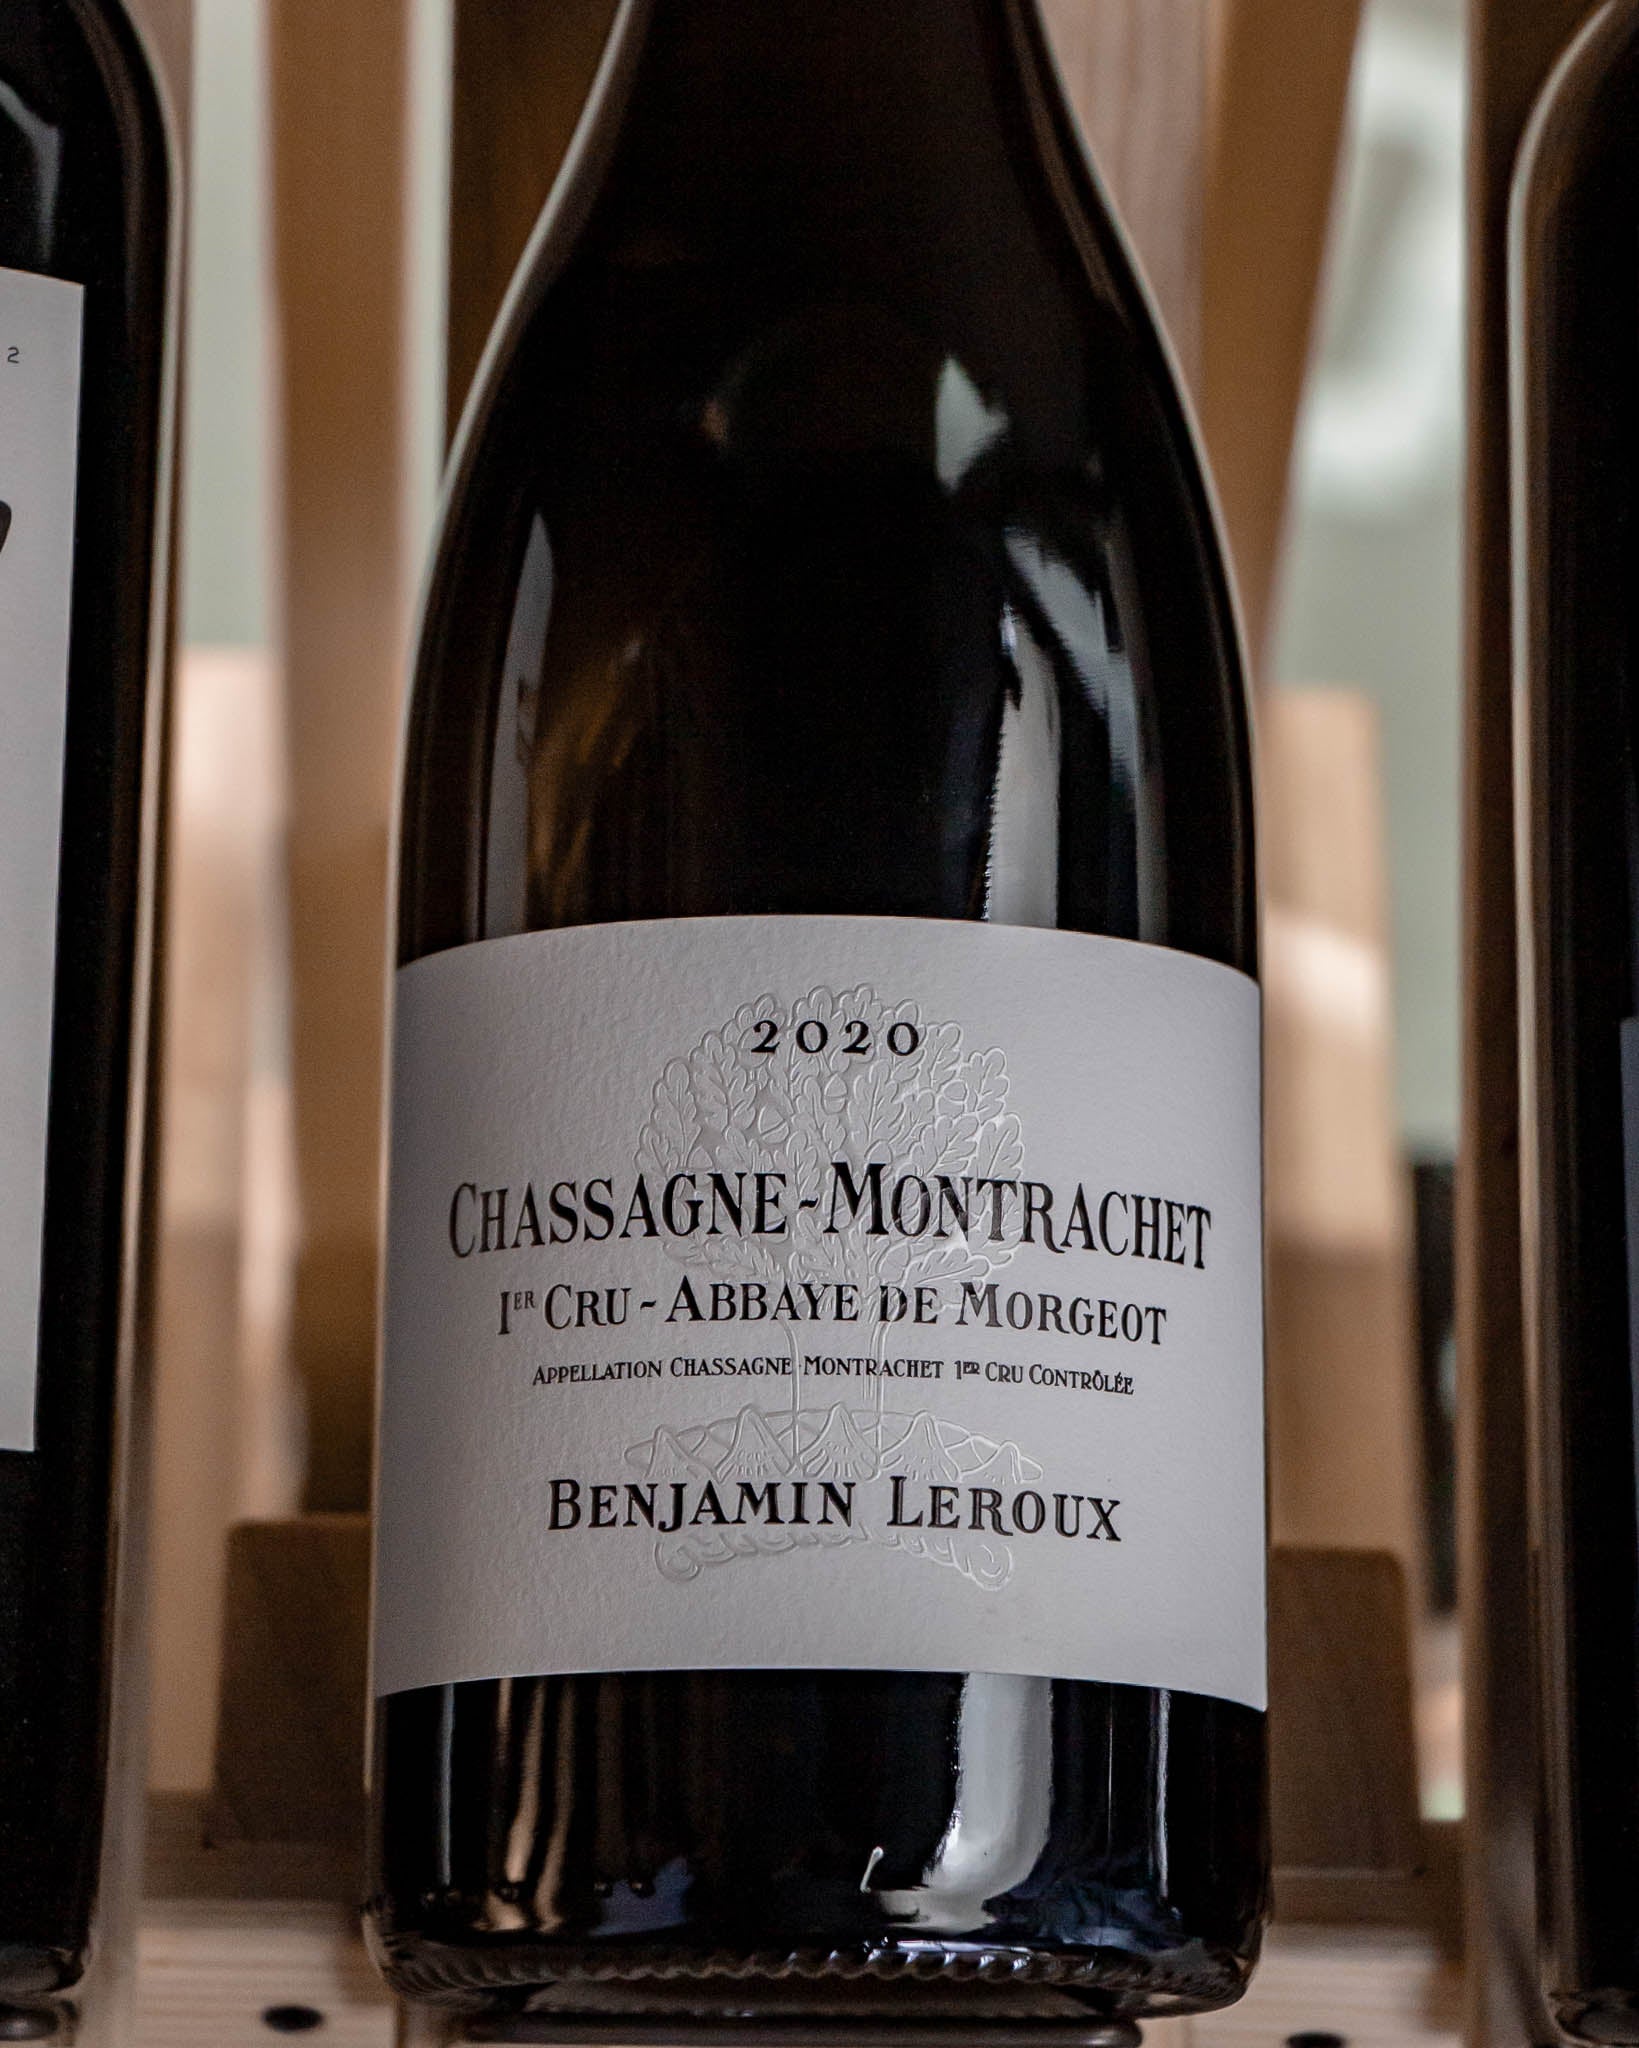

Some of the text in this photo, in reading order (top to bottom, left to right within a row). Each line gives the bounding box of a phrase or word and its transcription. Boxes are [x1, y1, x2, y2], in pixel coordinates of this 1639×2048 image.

[750, 1019, 919, 1057] 2020
[544, 1284, 632, 1330] CRU
[664, 1275, 859, 1322] ABBAYE
[878, 1284, 938, 1324] DE
[954, 1281, 1166, 1346] MORGEOT
[532, 1360, 662, 1386] APPELLATION
[985, 1361, 1024, 1385] CRU
[1028, 1364, 1135, 1396] CONTRÔLÉE
[547, 1475, 1122, 1543] BENJAMIN LEROUX
